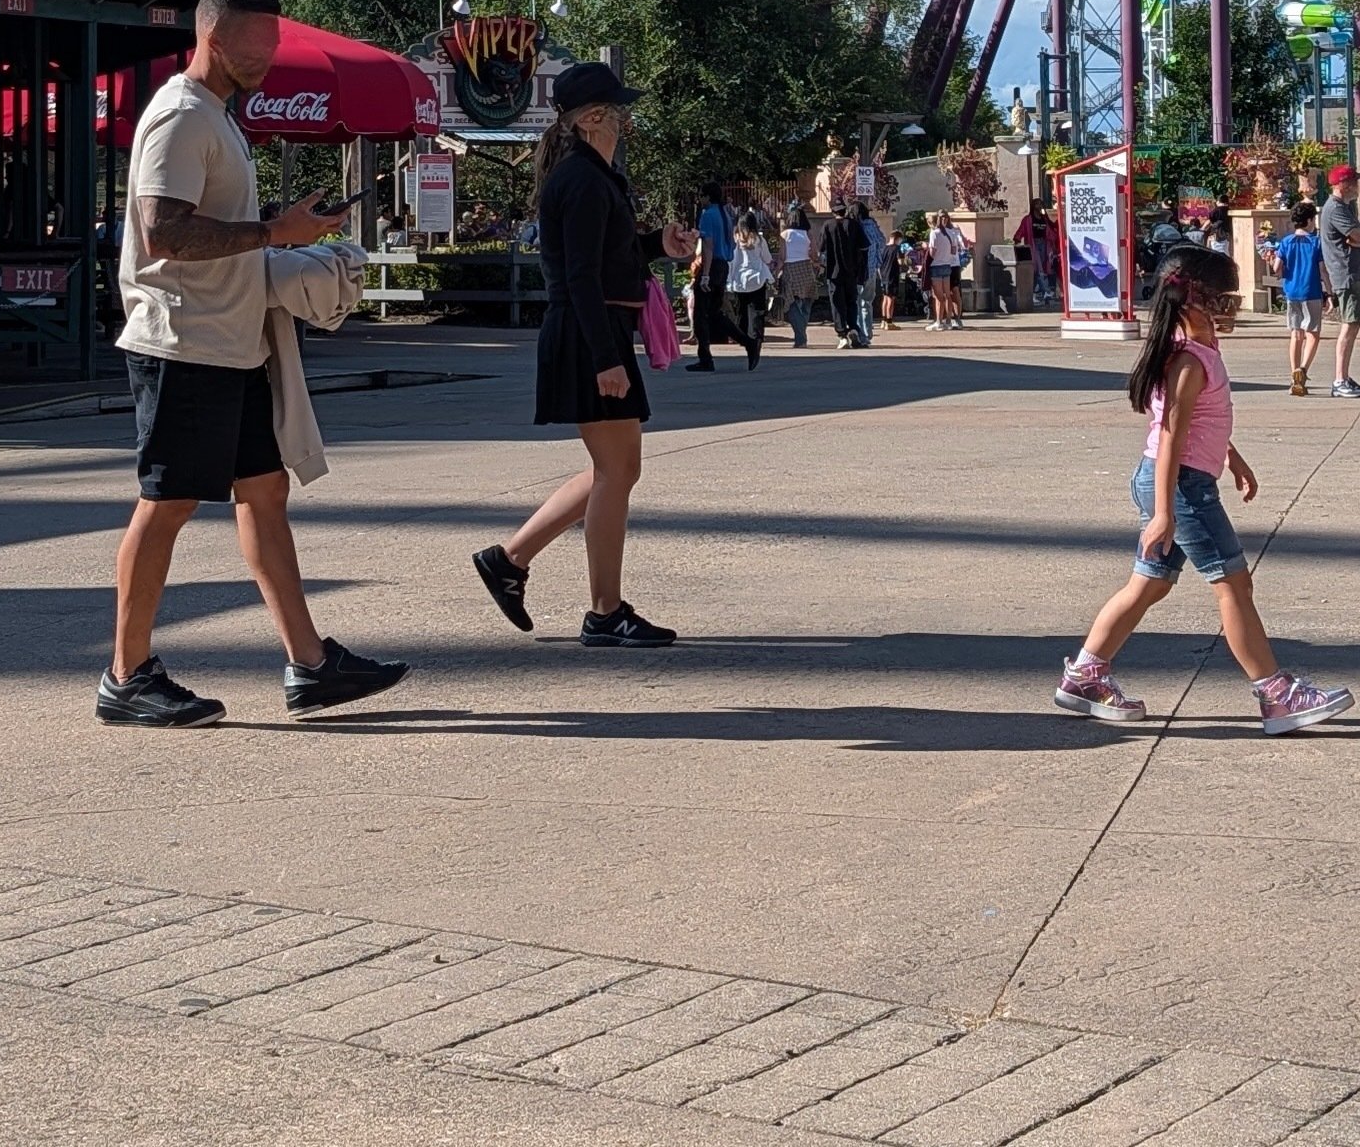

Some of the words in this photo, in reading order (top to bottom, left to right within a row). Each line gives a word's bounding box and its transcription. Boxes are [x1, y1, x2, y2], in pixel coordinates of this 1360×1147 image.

[152, 8, 176, 26] ENTER
[454, 16, 538, 83] VIPER
[246, 91, 331, 122] Coca-Cola
[858, 168, 872, 176] NO
[1070, 187, 1095, 197] MORE
[1071, 196, 1106, 205] SCOOPS
[1071, 206, 1088, 215] FOR
[1090, 206, 1113, 215] YOUR
[1071, 215, 1103, 224] MONEY
[16, 270, 53, 291] EXIT
